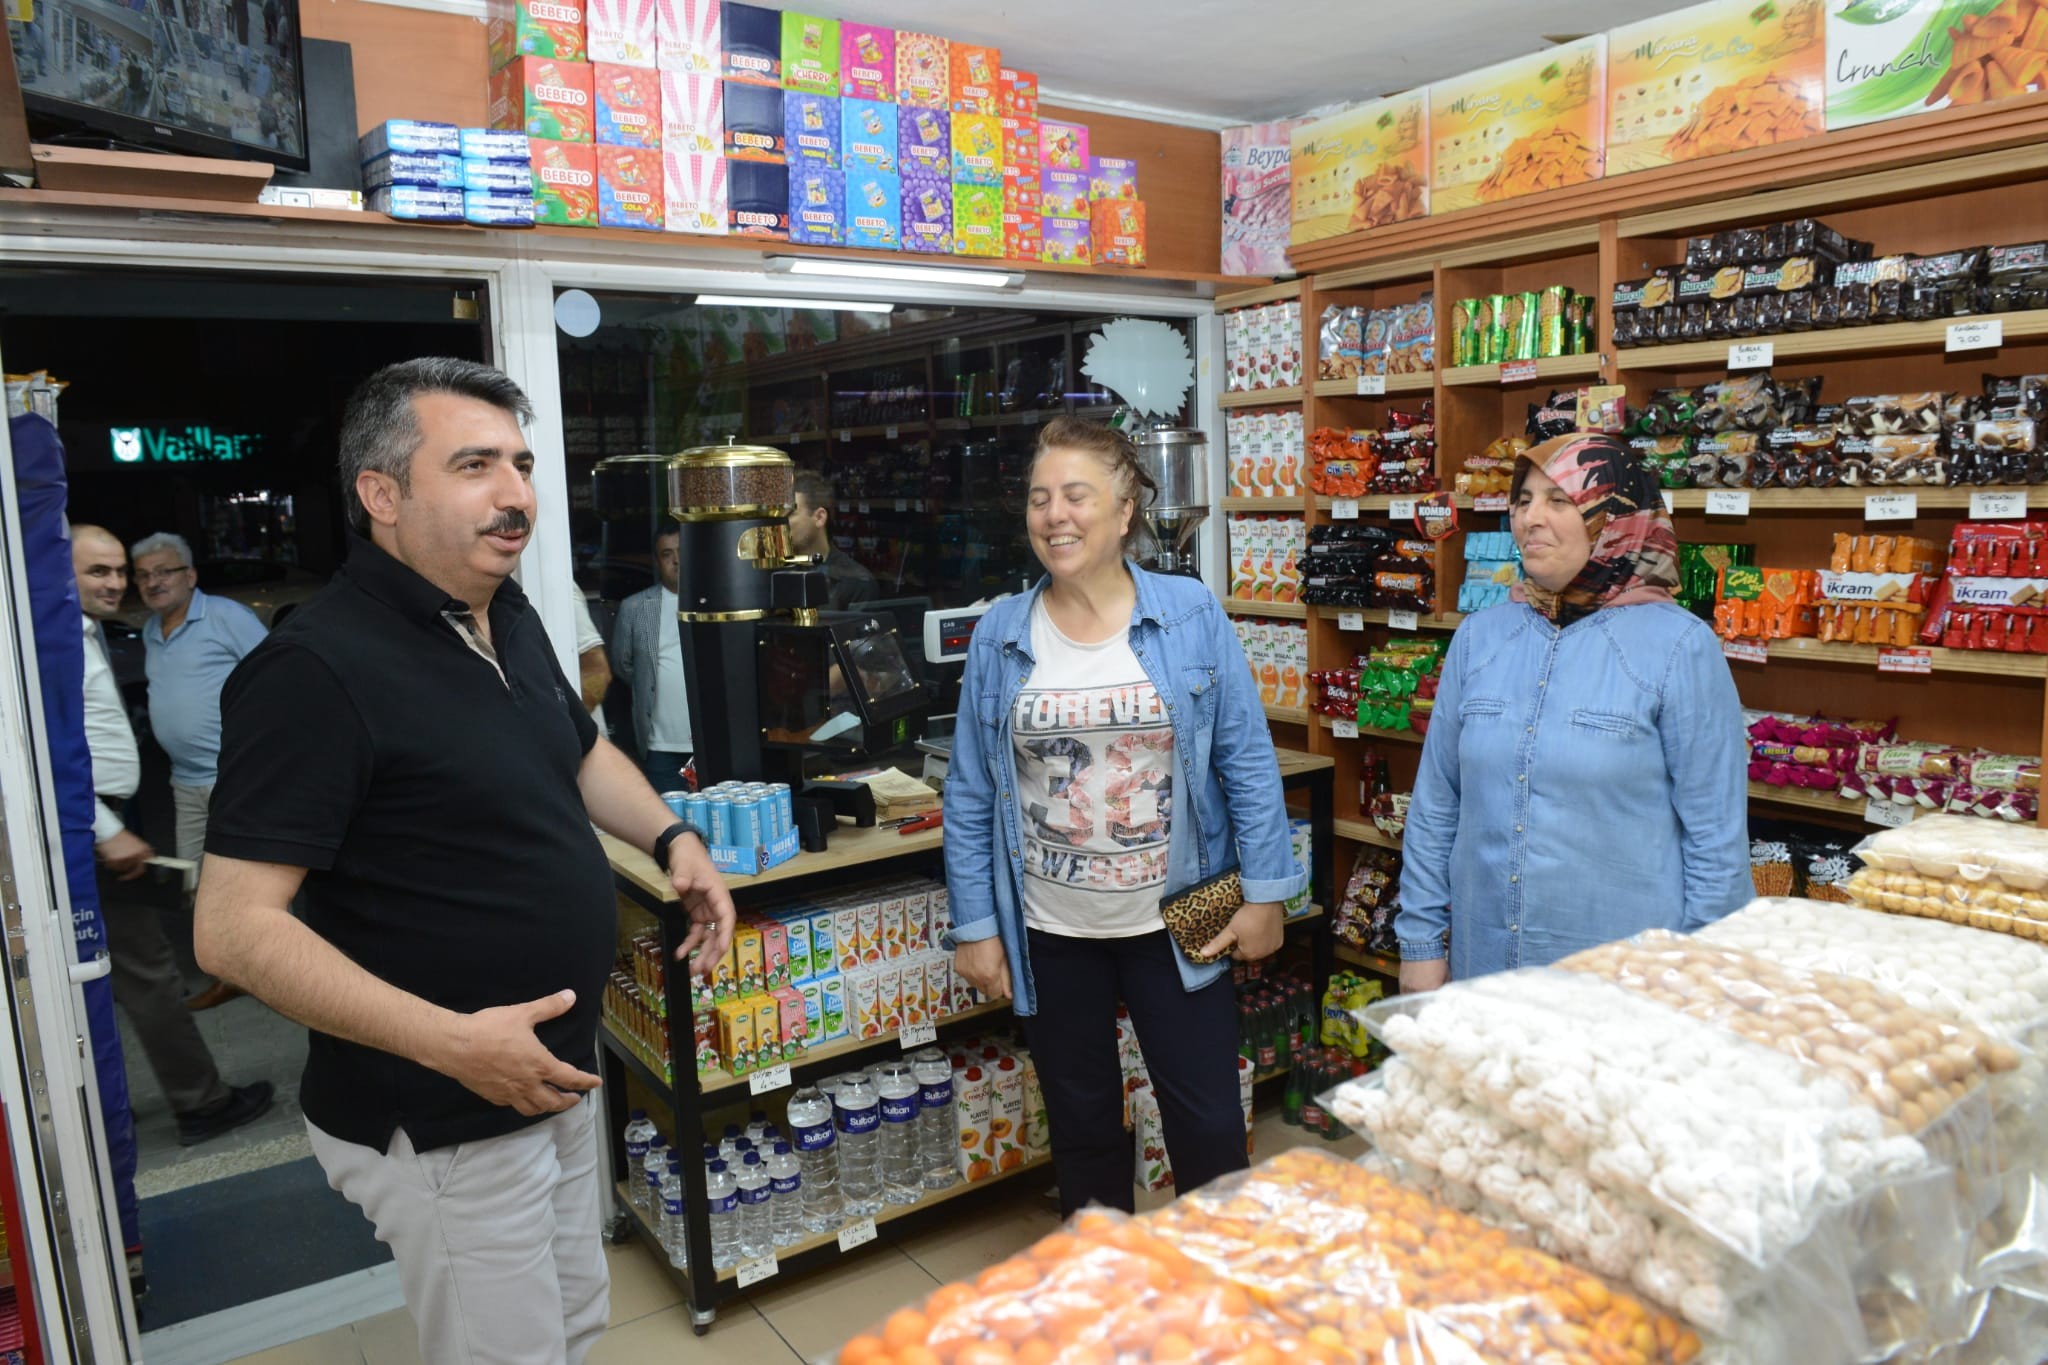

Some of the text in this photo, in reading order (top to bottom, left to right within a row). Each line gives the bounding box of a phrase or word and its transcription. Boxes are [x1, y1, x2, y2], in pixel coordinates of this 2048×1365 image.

[531, 4, 581, 23] BEBETO
[731, 54, 770, 71] BEBETO
[1836, 32, 1942, 83] Crunch
[796, 70, 830, 83] CHERRY
[852, 70, 881, 82] BEBETO
[537, 86, 586, 104] BEBETO
[612, 113, 647, 125] BEBETO
[619, 125, 640, 134] COLA
[735, 134, 774, 149] BEBETO
[799, 136, 829, 148] BEBETO
[854, 144, 883, 155] BEBETO
[913, 147, 938, 158] BEBETO
[966, 157, 994, 167] BEBETO
[542, 168, 592, 186] BEBETO
[615, 191, 650, 204] BEBETO
[622, 203, 643, 212] COLA
[671, 200, 699, 211] BEBETO
[738, 212, 778, 227] BEBETO
[803, 212, 834, 223] BEBETO
[856, 217, 886, 228] BEBETO
[915, 223, 941, 234] BEBETO
[1745, 269, 1784, 286] Burçak
[1680, 276, 1717, 294] Burçak
[1384, 430, 1410, 440] KOMBO
[1381, 460, 1406, 471] KOMBO
[1418, 505, 1452, 517] KOMBO
[1826, 581, 1874, 596] ikram
[1955, 585, 2008, 600] ikram
[711, 848, 738, 863] BLUE
[925, 1089, 951, 1102] Sultan
[882, 1102, 910, 1115] Sultan
[850, 1113, 878, 1128] Sultan
[803, 1127, 832, 1143] Sultan
[774, 1180, 797, 1190] Sultan
